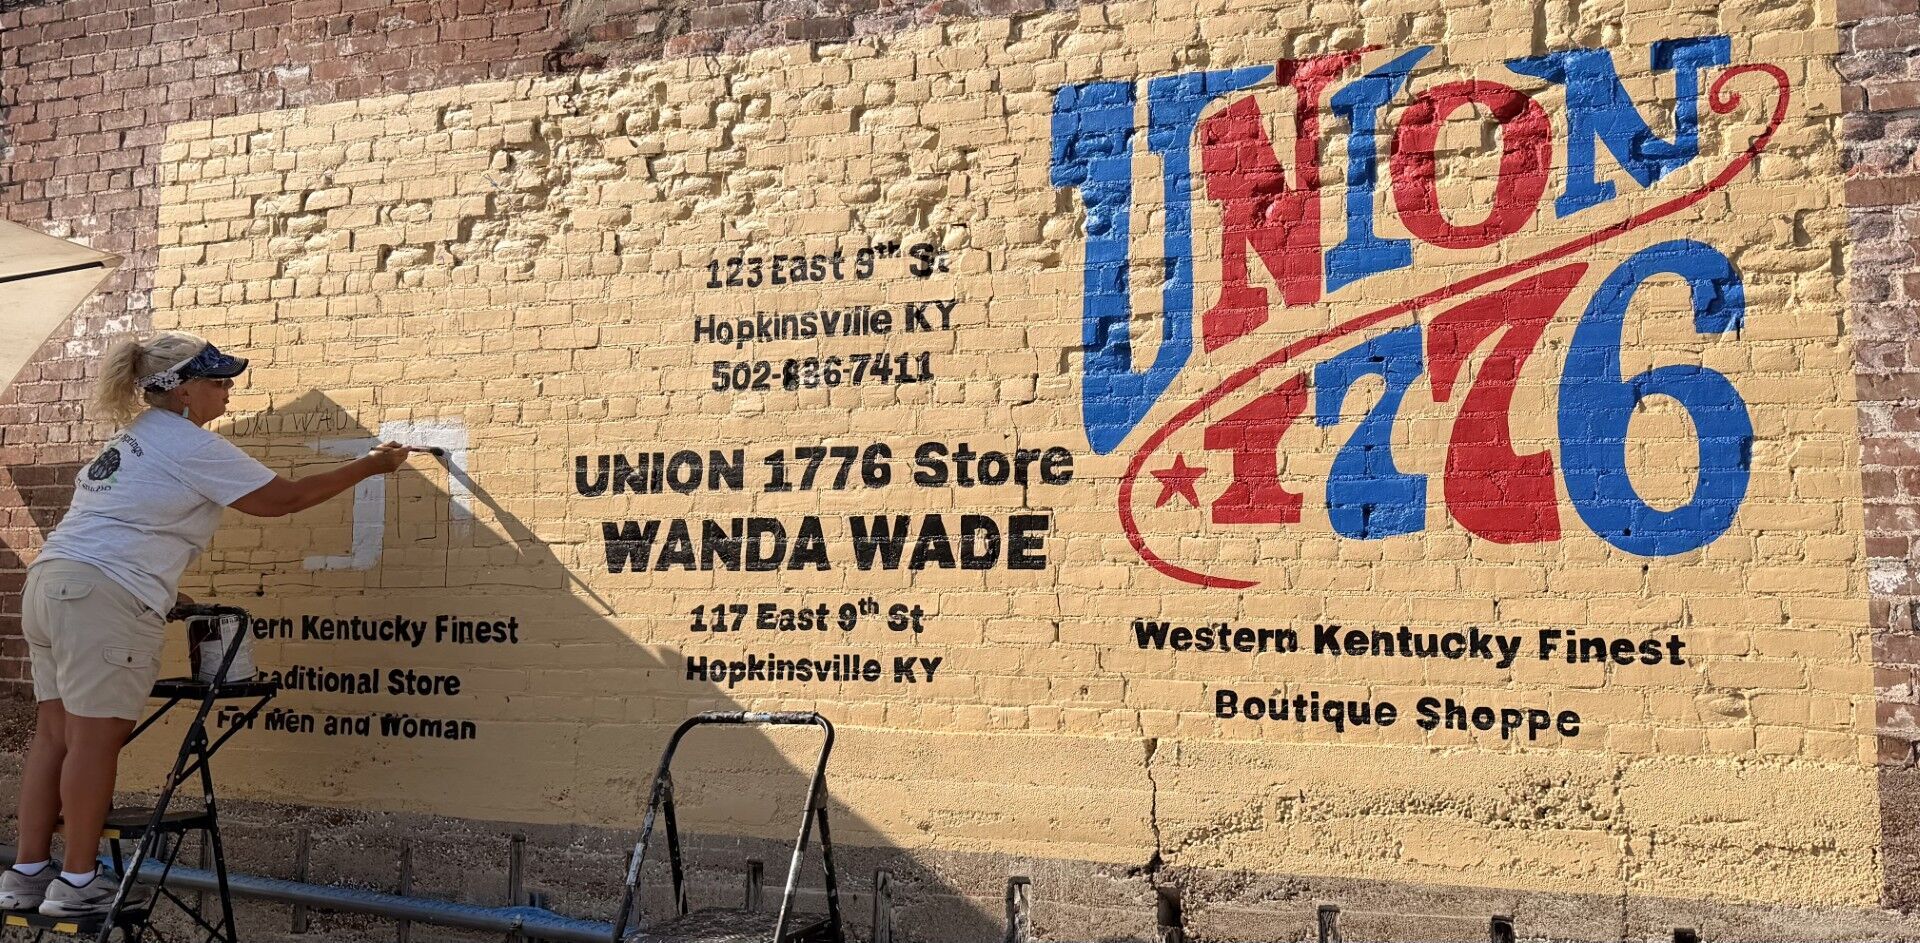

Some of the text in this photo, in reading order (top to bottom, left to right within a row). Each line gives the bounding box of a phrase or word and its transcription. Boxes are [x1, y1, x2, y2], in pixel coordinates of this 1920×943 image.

[706, 240, 950, 289] 123 East 9th St
[1050, 34, 1731, 455] UNION
[694, 301, 957, 349] Hopkinsville KY
[1203, 239, 1755, 557] 1776
[574, 441, 1075, 497] UNION 1776 Store
[600, 514, 1051, 574] WANDA WADE
[250, 614, 520, 647] ern Kentucky Finest
[690, 597, 925, 634] 117 East 9th St
[1132, 617, 1687, 669] Western Kentucky Finest
[256, 665, 461, 696] raditional Store
[686, 653, 943, 689] Hopkinsville KY
[216, 705, 477, 740] For Men and Woman
[1215, 689, 1581, 741] Boutique Shoppe
